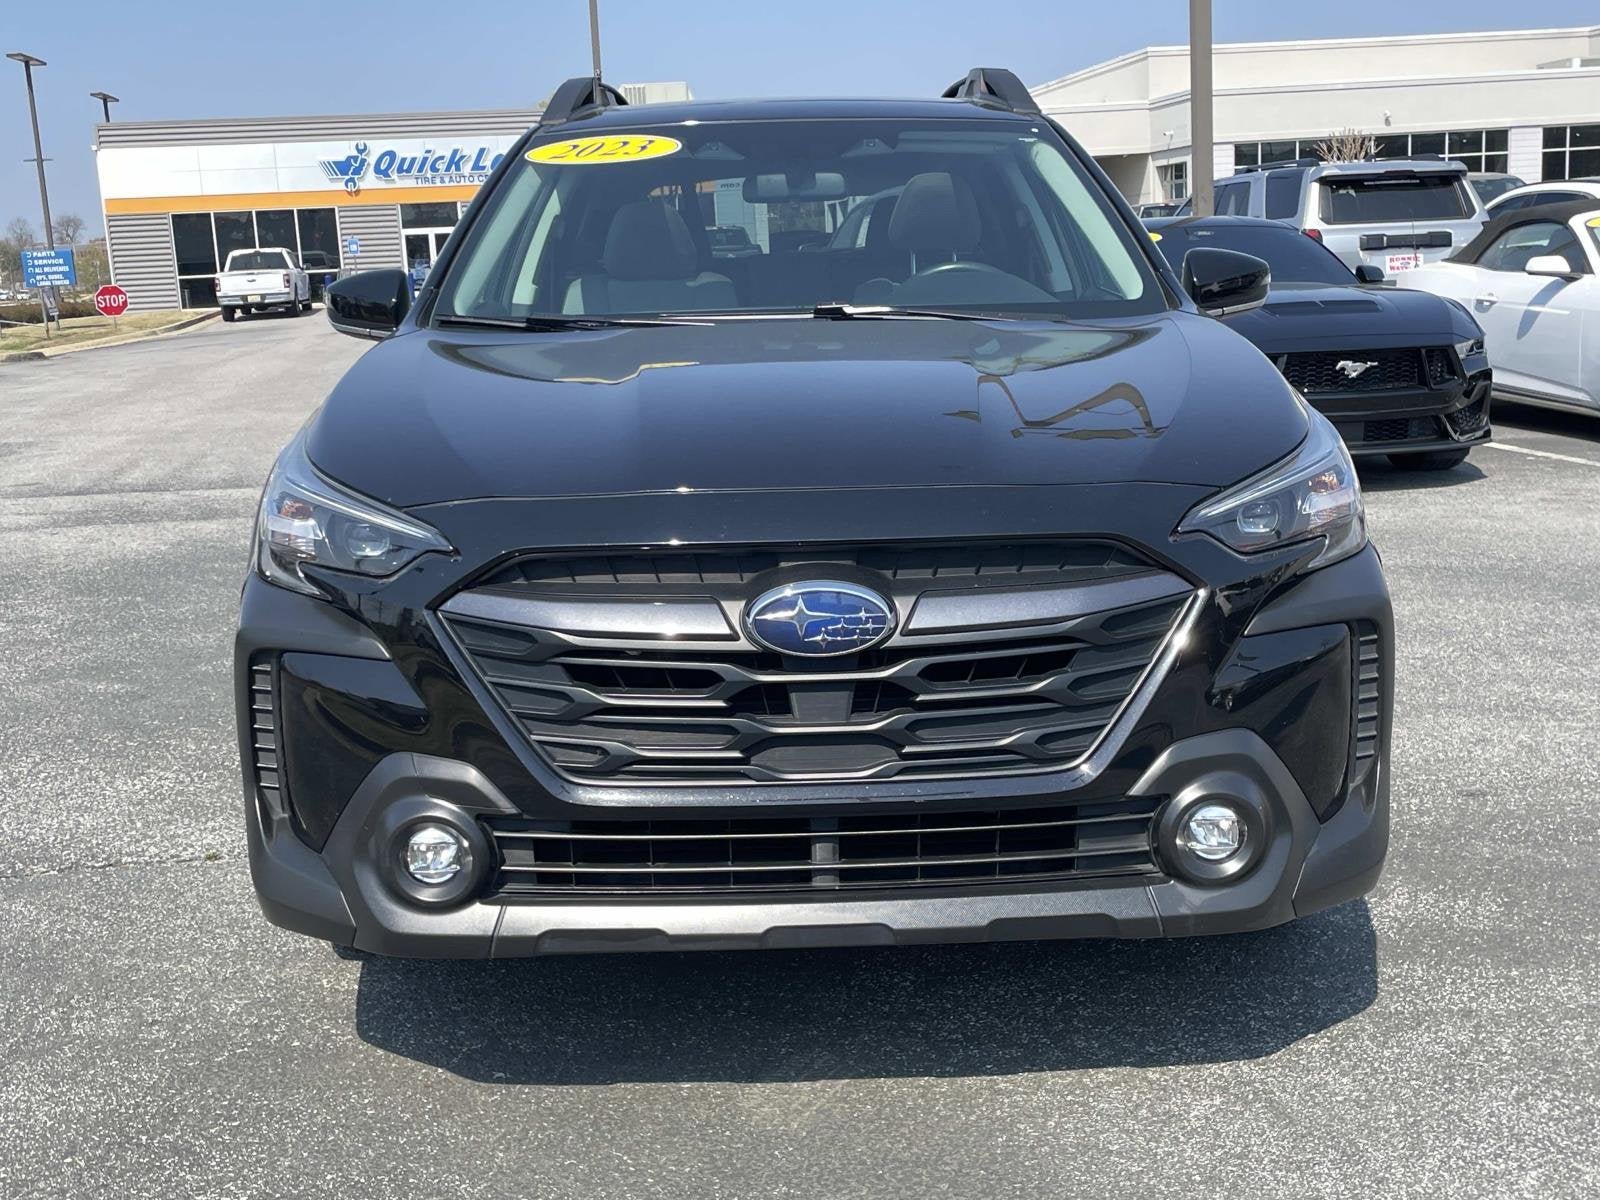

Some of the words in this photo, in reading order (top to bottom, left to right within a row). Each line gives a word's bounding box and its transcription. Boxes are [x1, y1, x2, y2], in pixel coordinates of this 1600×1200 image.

[550, 138, 656, 160] 2023
[373, 148, 467, 179] Quick
[414, 176, 437, 185] TIRE
[439, 175, 446, 184] &
[448, 174, 475, 184] AUTO
[97, 294, 126, 308] STOP
